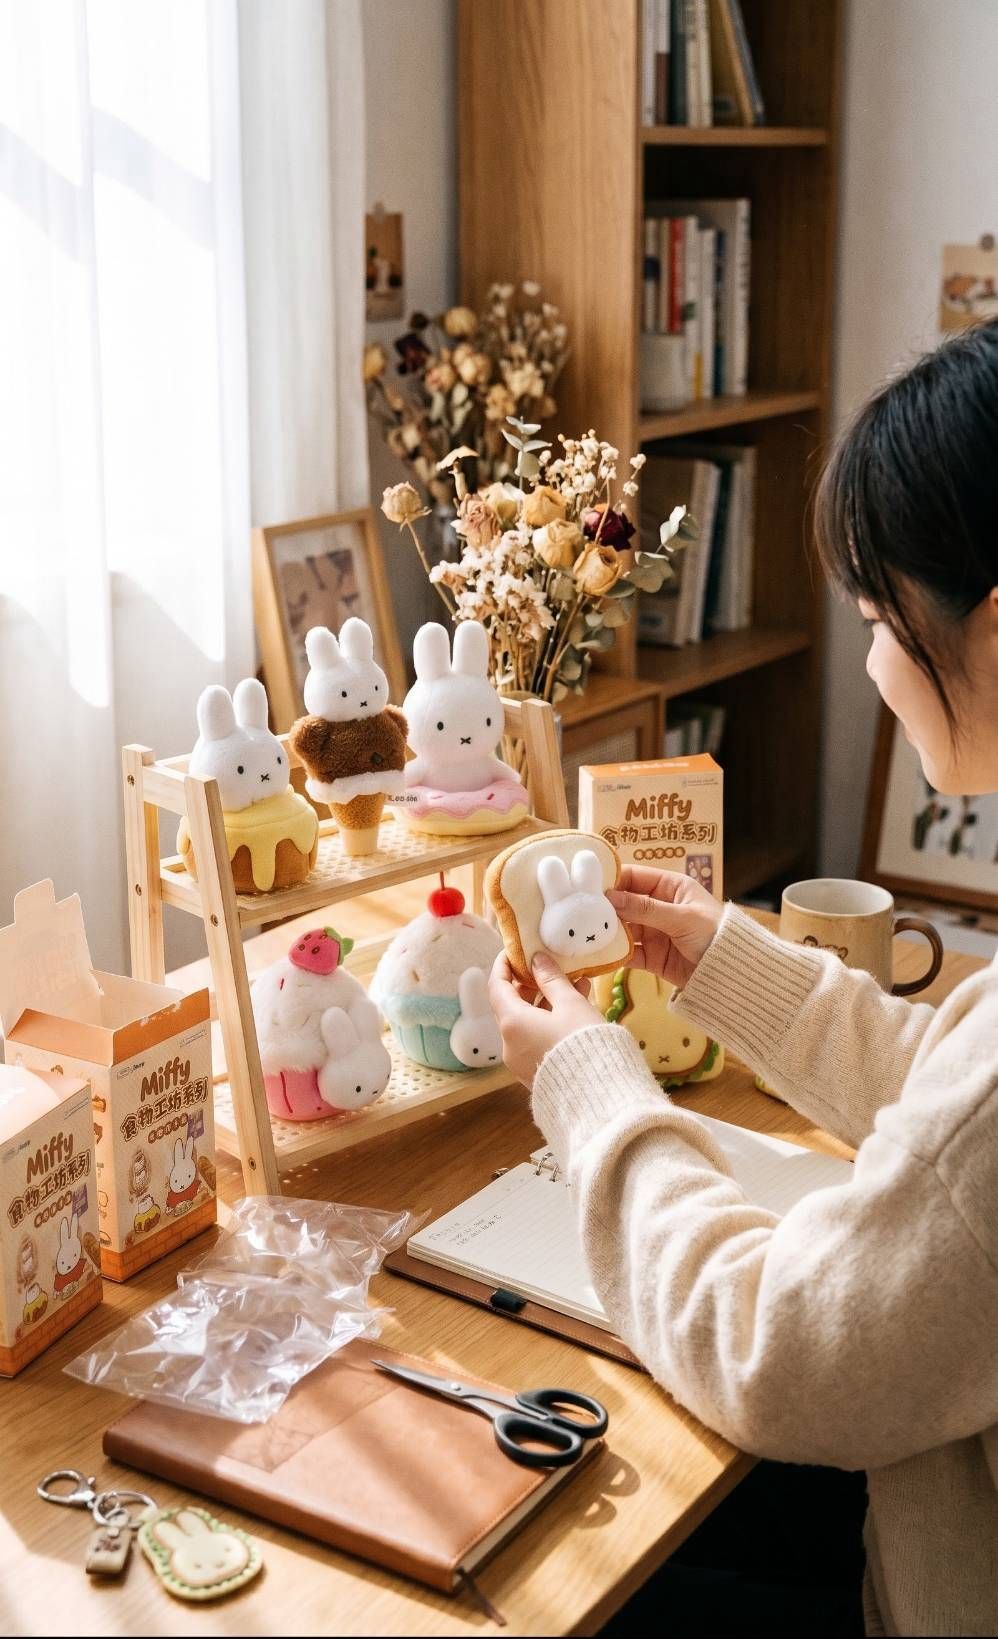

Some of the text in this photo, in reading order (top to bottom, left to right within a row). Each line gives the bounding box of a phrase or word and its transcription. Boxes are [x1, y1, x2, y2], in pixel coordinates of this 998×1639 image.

[626, 793, 692, 821] Miffy
[141, 1056, 191, 1102] Miffy
[27, 1132, 73, 1184] Miffy
